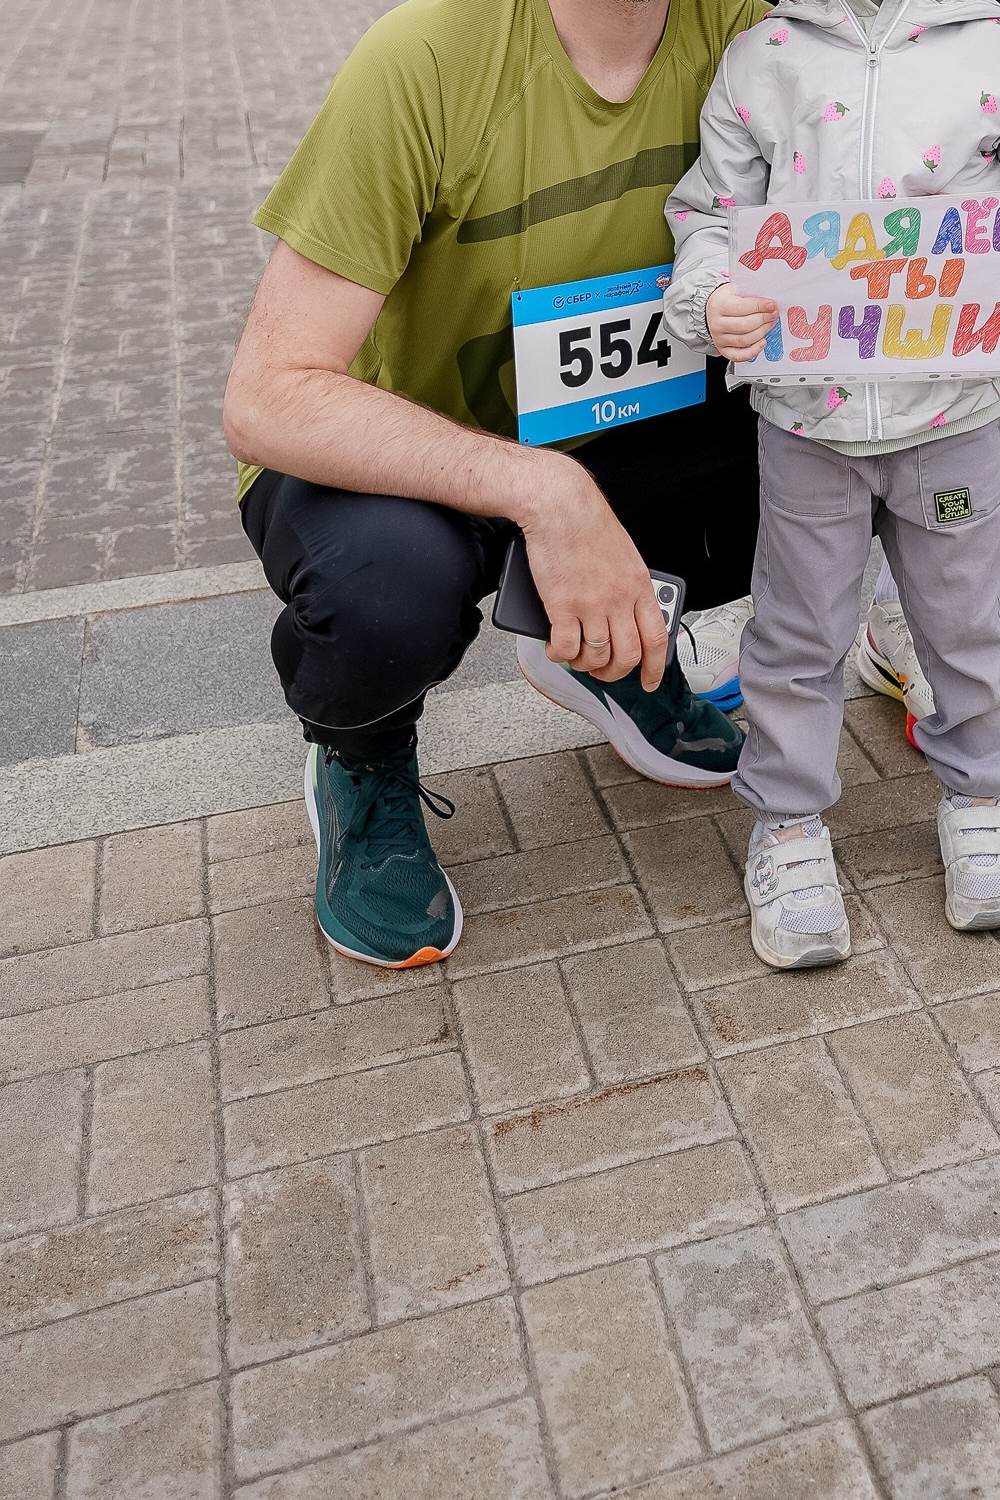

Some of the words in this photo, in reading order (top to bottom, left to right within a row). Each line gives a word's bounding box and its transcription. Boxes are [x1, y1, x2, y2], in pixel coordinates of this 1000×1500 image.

[738, 206, 922, 271] ДЯДЯ
[850, 256, 966, 300] ТЫ
[566, 292, 592, 304] СБЕР
[559, 311, 671, 388] 554
[939, 493, 966, 502] CREATE
[943, 500, 964, 508] YOUR
[945, 505, 964, 513] OWN
[941, 509, 968, 519] FUTURE
